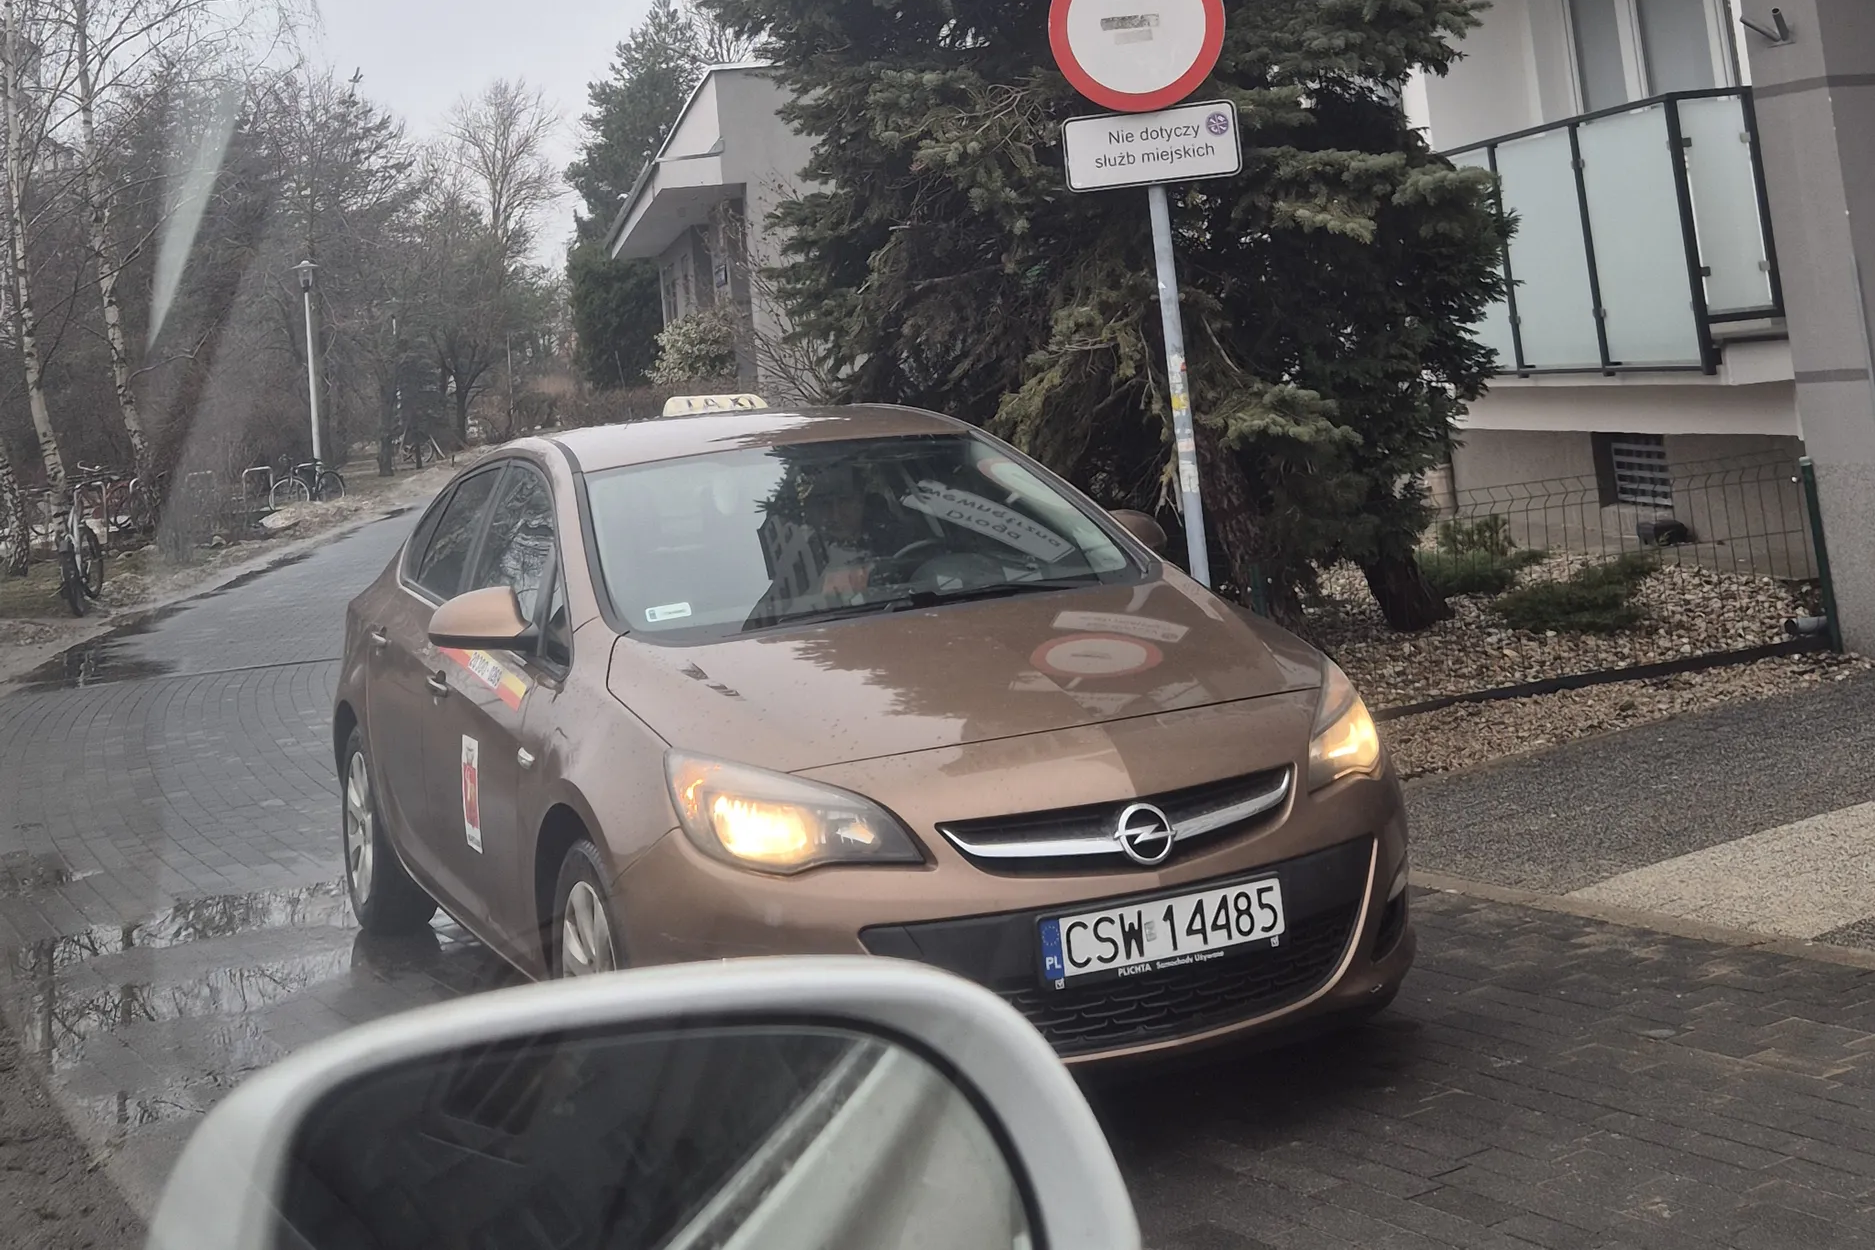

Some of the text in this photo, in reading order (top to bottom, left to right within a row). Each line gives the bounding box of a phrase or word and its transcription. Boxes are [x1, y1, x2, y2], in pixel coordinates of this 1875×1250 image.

[1108, 129, 1135, 145] Nie
[1139, 124, 1200, 142] dotyczy
[1095, 143, 1215, 168] służb miejskich
[1065, 886, 1279, 968] CSW 14485
[1045, 956, 1062, 971] PL
[1117, 963, 1152, 977] PLICHTA
